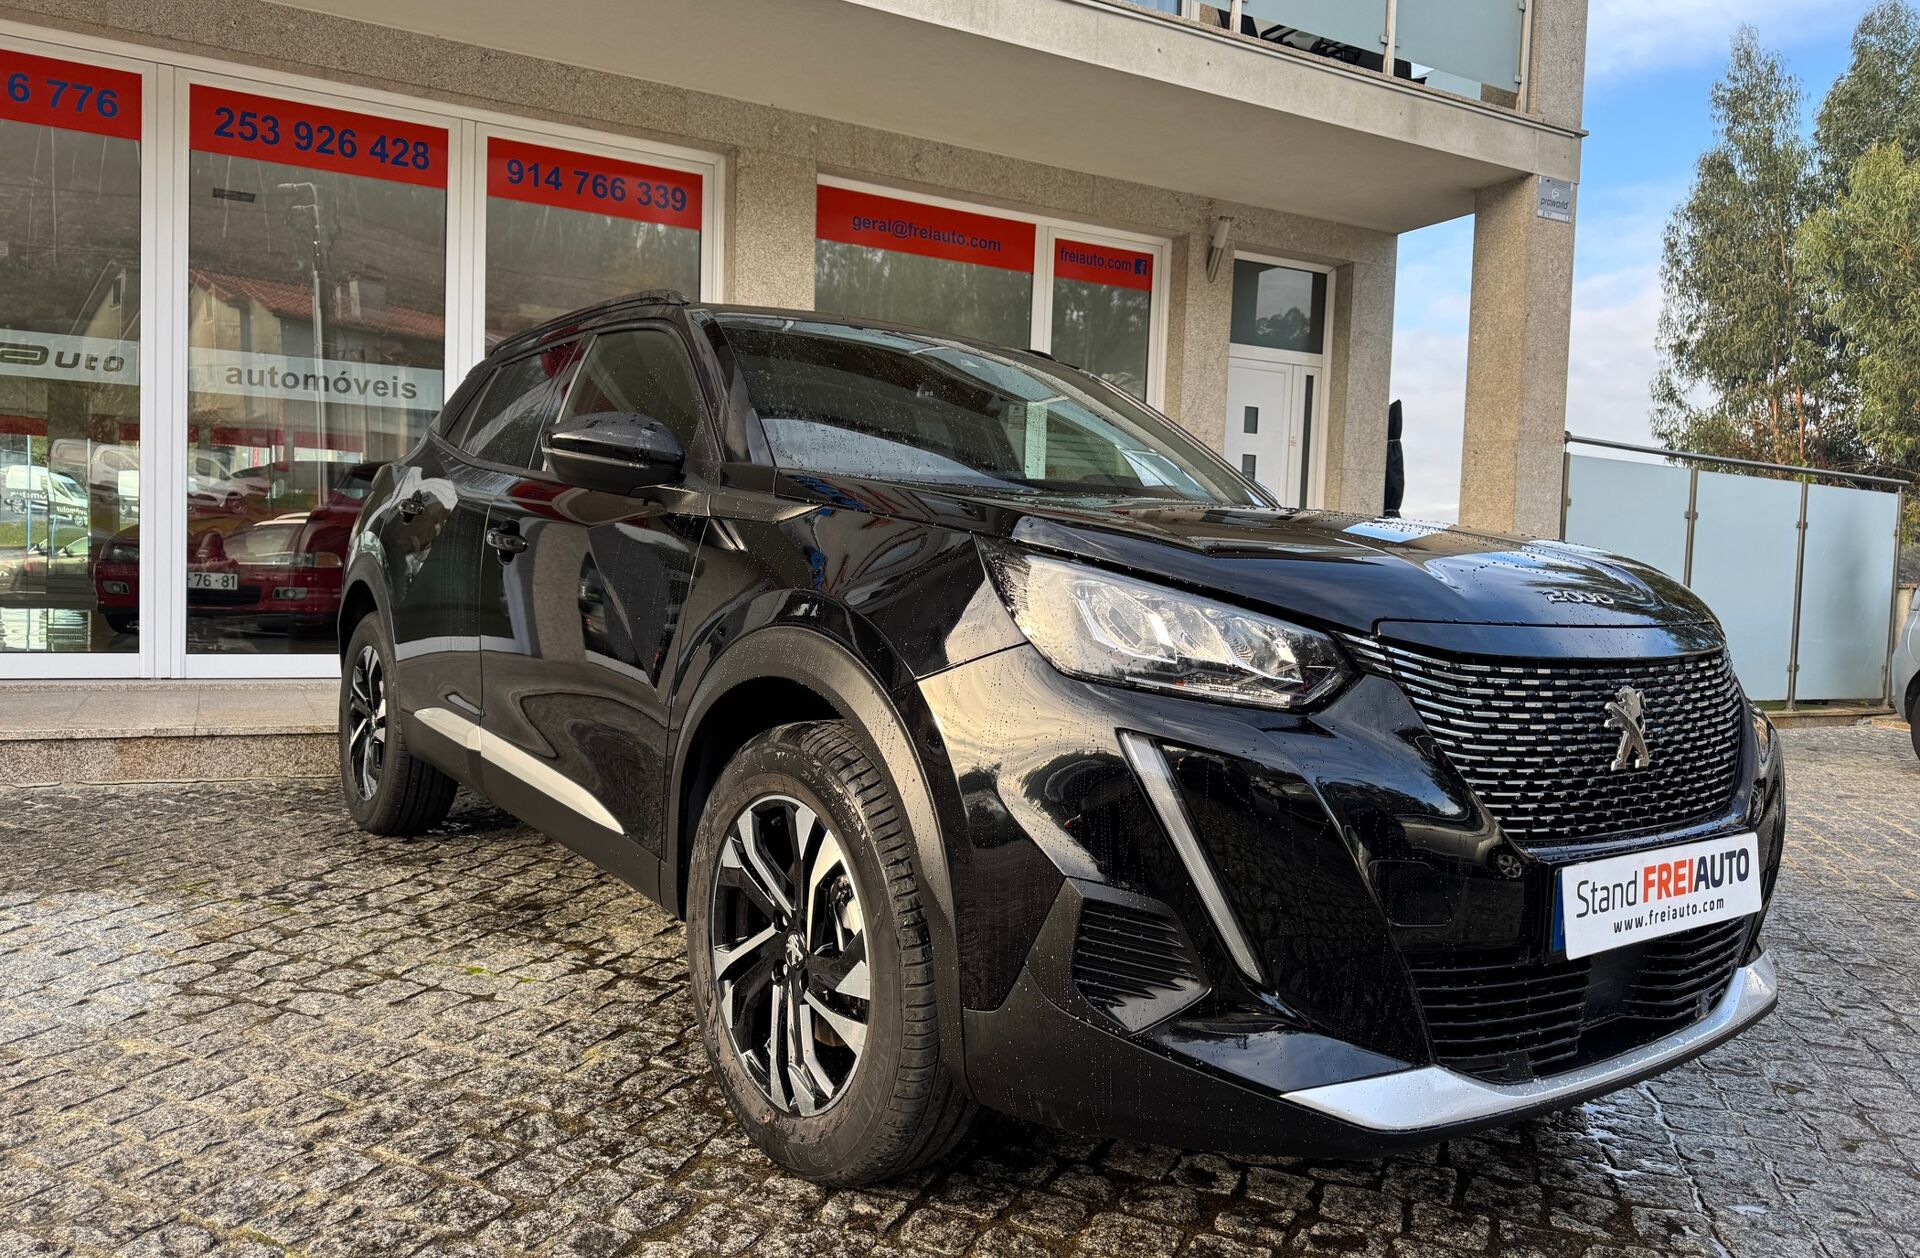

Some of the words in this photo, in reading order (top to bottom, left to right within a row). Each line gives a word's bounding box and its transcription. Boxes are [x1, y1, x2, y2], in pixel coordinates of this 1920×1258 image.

[7, 72, 31, 103] 6
[46, 79, 119, 118] 776
[213, 106, 281, 146] 253
[293, 120, 358, 159] 926
[368, 134, 430, 170] 428
[506, 158, 563, 192] 914
[573, 170, 627, 202] 766
[636, 181, 688, 212] 339
[852, 214, 1001, 252] geral@freiauto.com
[1060, 248, 1132, 272] freiauto.com
[225, 365, 417, 400] automóveis
[1576, 870, 1638, 919] Stand
[1642, 847, 1750, 904] FREIAUTO
[1613, 896, 1725, 934] www.freiauto.com
